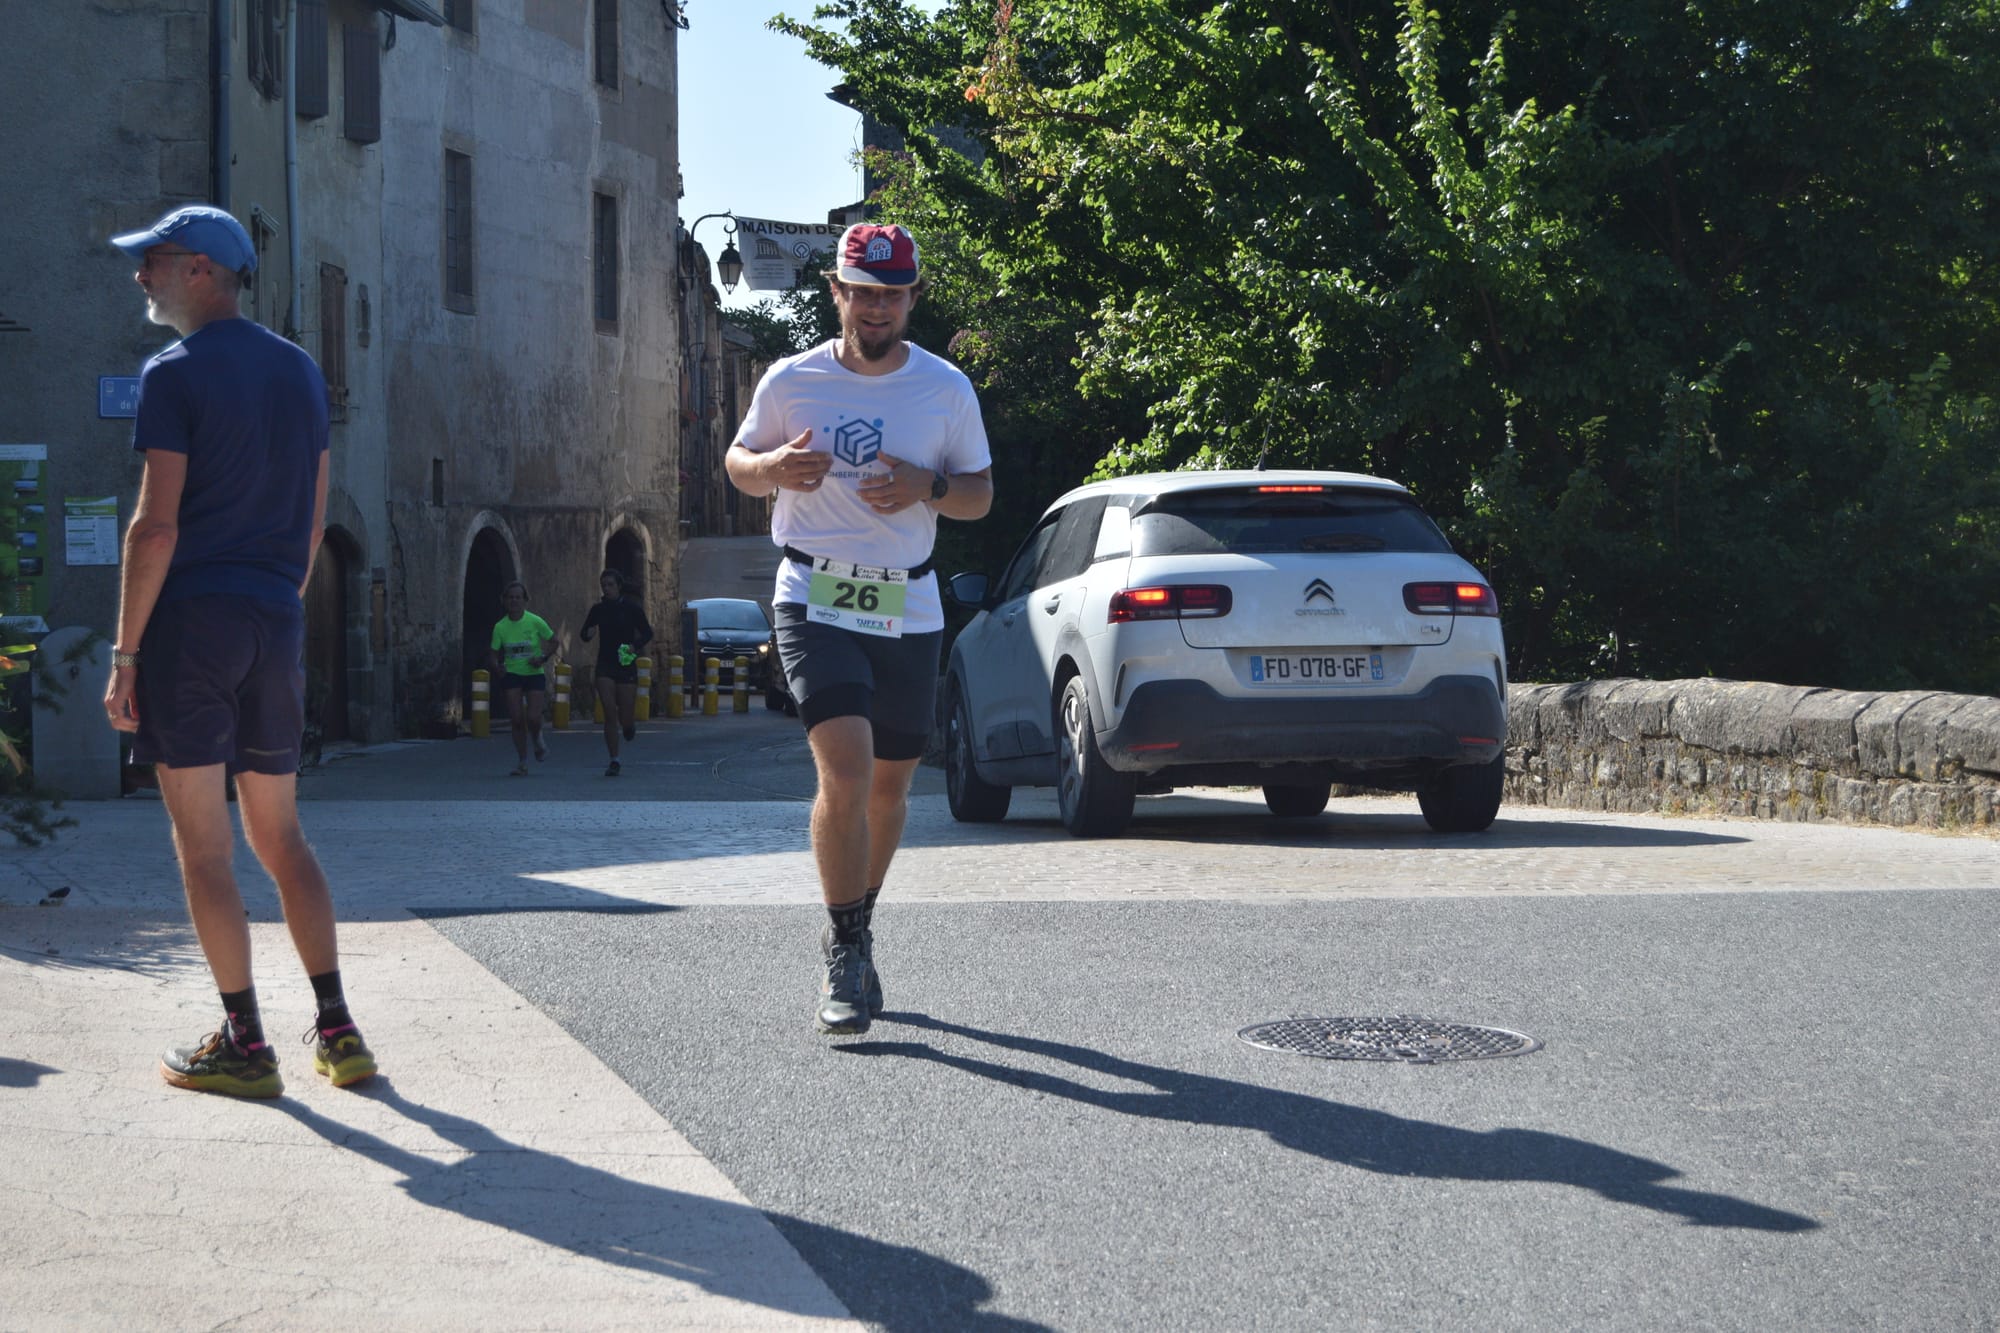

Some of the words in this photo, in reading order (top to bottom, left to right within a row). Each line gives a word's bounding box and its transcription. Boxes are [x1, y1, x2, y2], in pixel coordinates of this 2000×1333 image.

[741, 221, 810, 235] MAISON
[868, 248, 891, 259] RISE
[130, 384, 140, 395] PL
[832, 582, 879, 612] 26
[1265, 657, 1366, 679] FD-078-GF
[1373, 668, 1383, 678] 13
